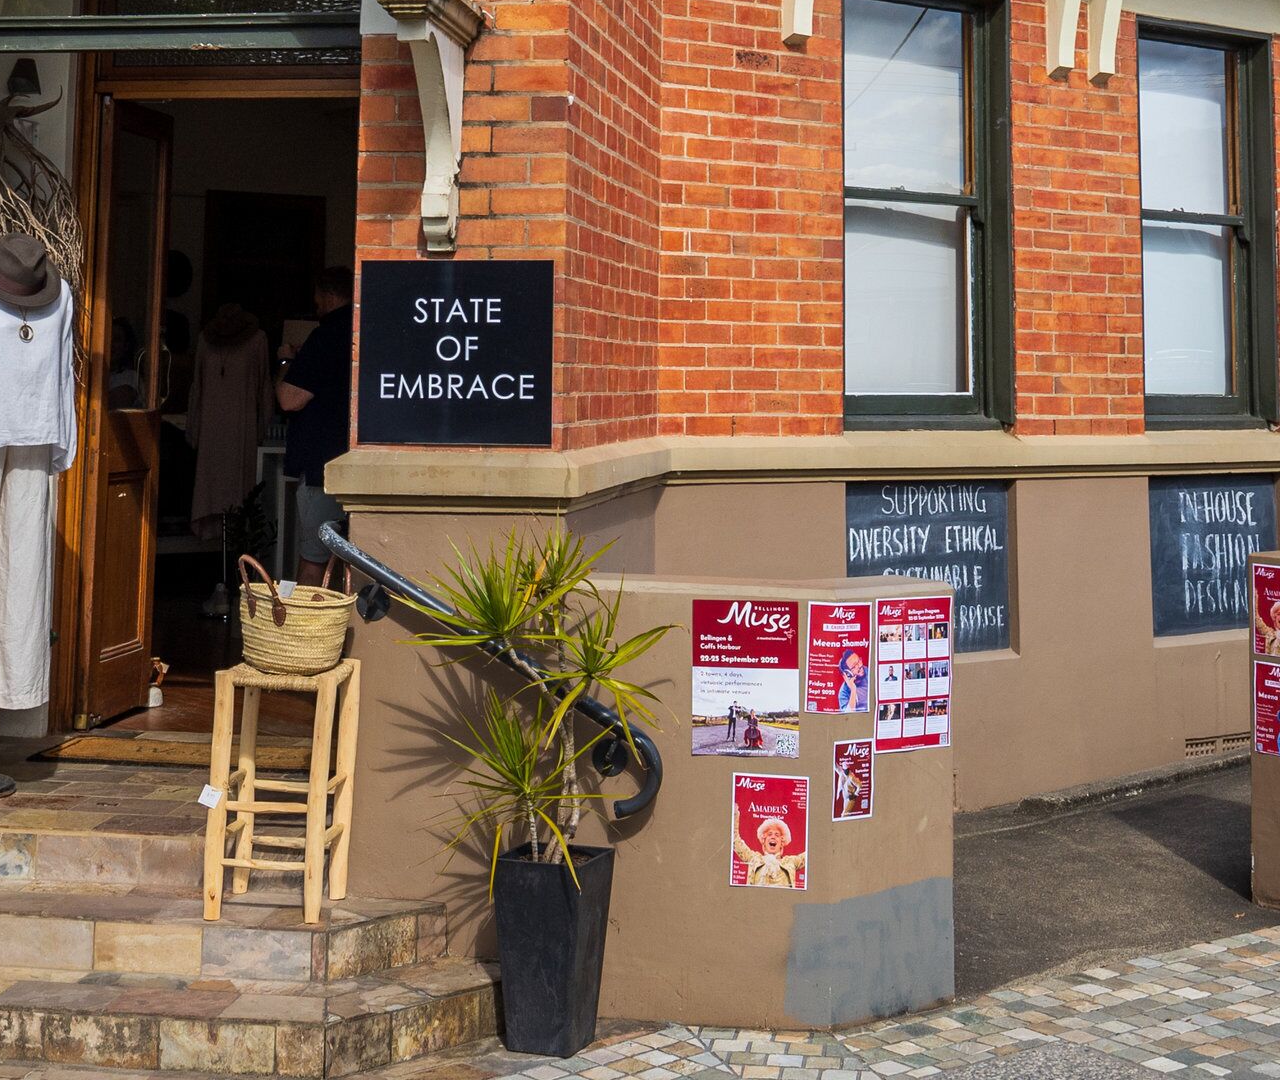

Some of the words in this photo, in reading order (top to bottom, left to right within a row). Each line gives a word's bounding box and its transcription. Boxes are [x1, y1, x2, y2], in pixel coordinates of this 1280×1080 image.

[413, 298, 501, 324] STATE
[436, 335, 479, 361] OF
[380, 373, 535, 399] EMBRACE
[881, 485, 986, 515] SUPPORTING
[1179, 490, 1257, 526] IN-HOUSE
[849, 524, 930, 561] DIVERSITY
[945, 524, 1004, 553] ETHICAL
[1182, 533, 1259, 570] FASHION
[717, 601, 790, 632] Muse
[829, 607, 856, 620] Muse
[879, 605, 901, 617] Muse
[700, 634, 726, 642] Bellingen
[813, 639, 840, 647] Meena
[842, 639, 870, 648] Shamaly
[721, 654, 758, 664] September
[844, 744, 869, 757] Muse
[736, 777, 765, 791] Muse
